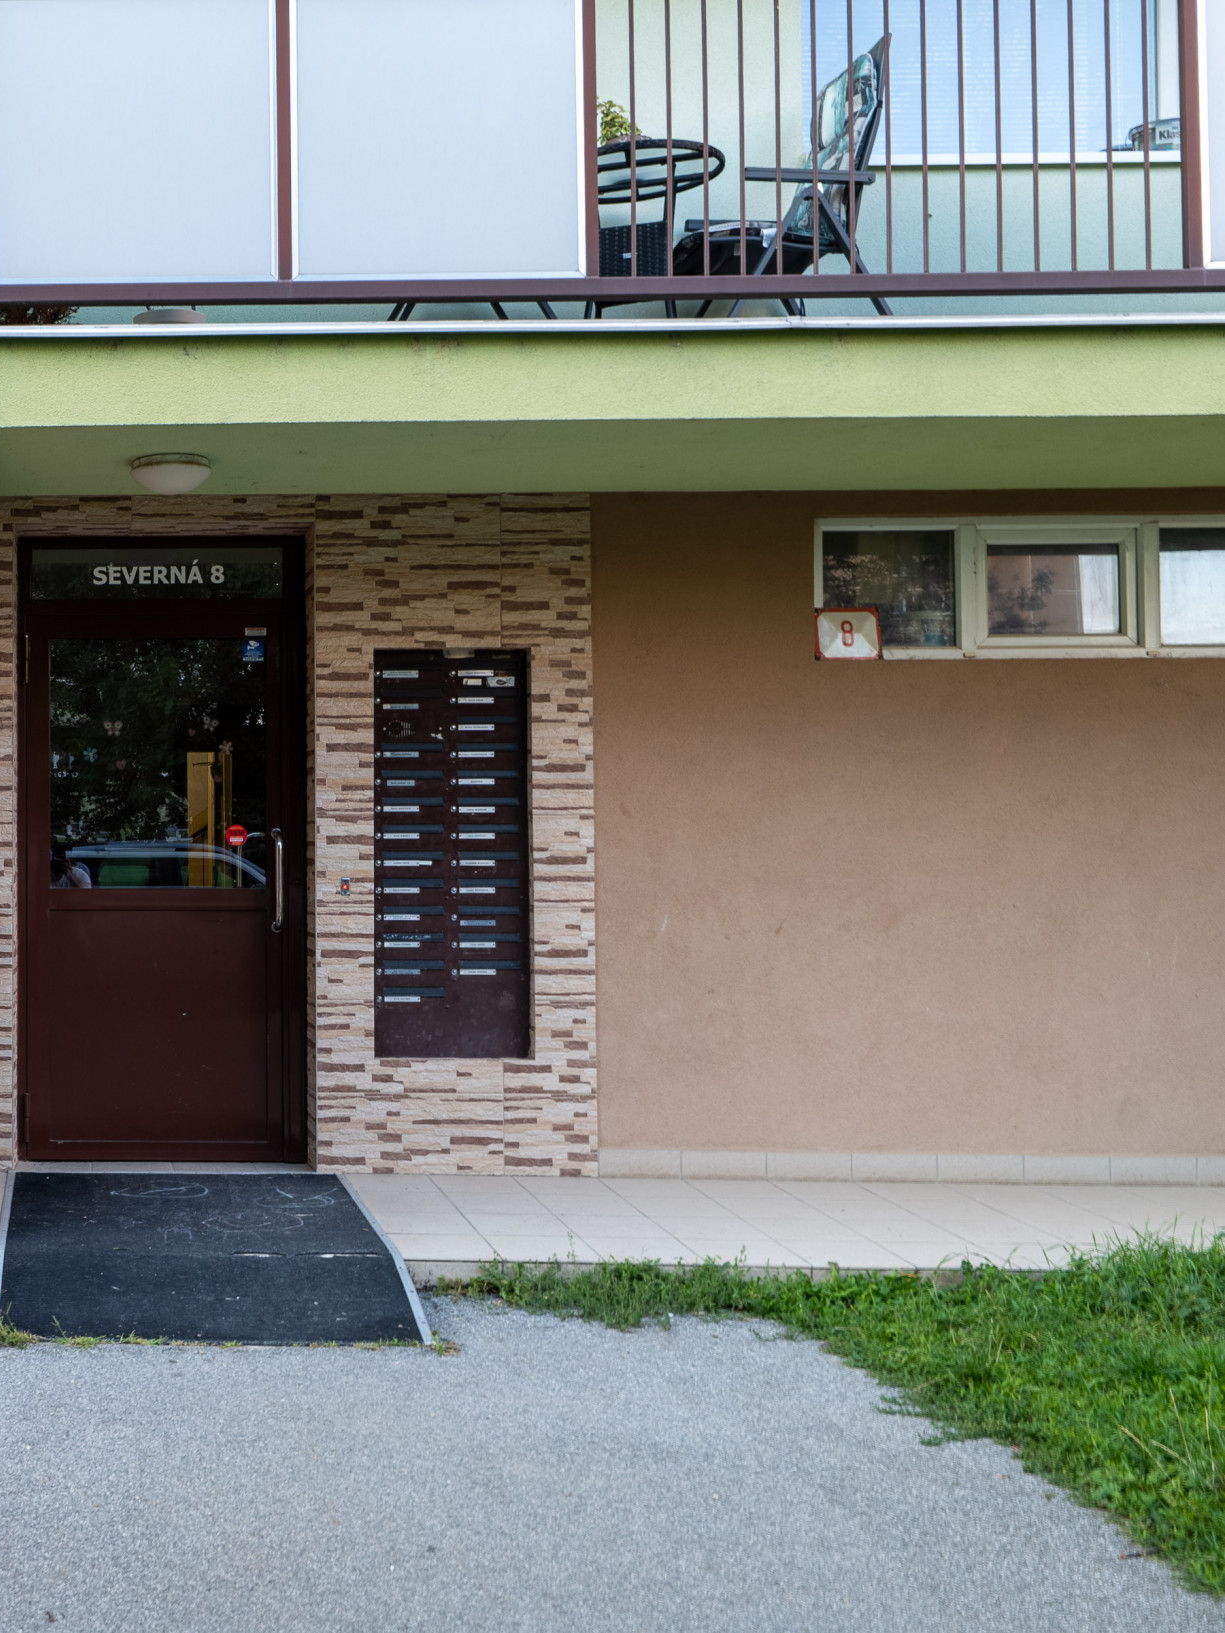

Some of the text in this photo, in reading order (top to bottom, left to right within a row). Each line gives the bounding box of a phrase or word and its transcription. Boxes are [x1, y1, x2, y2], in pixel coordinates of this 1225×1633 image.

[93, 559, 224, 585] SEVERNÁ 8
[840, 620, 854, 647] 8
